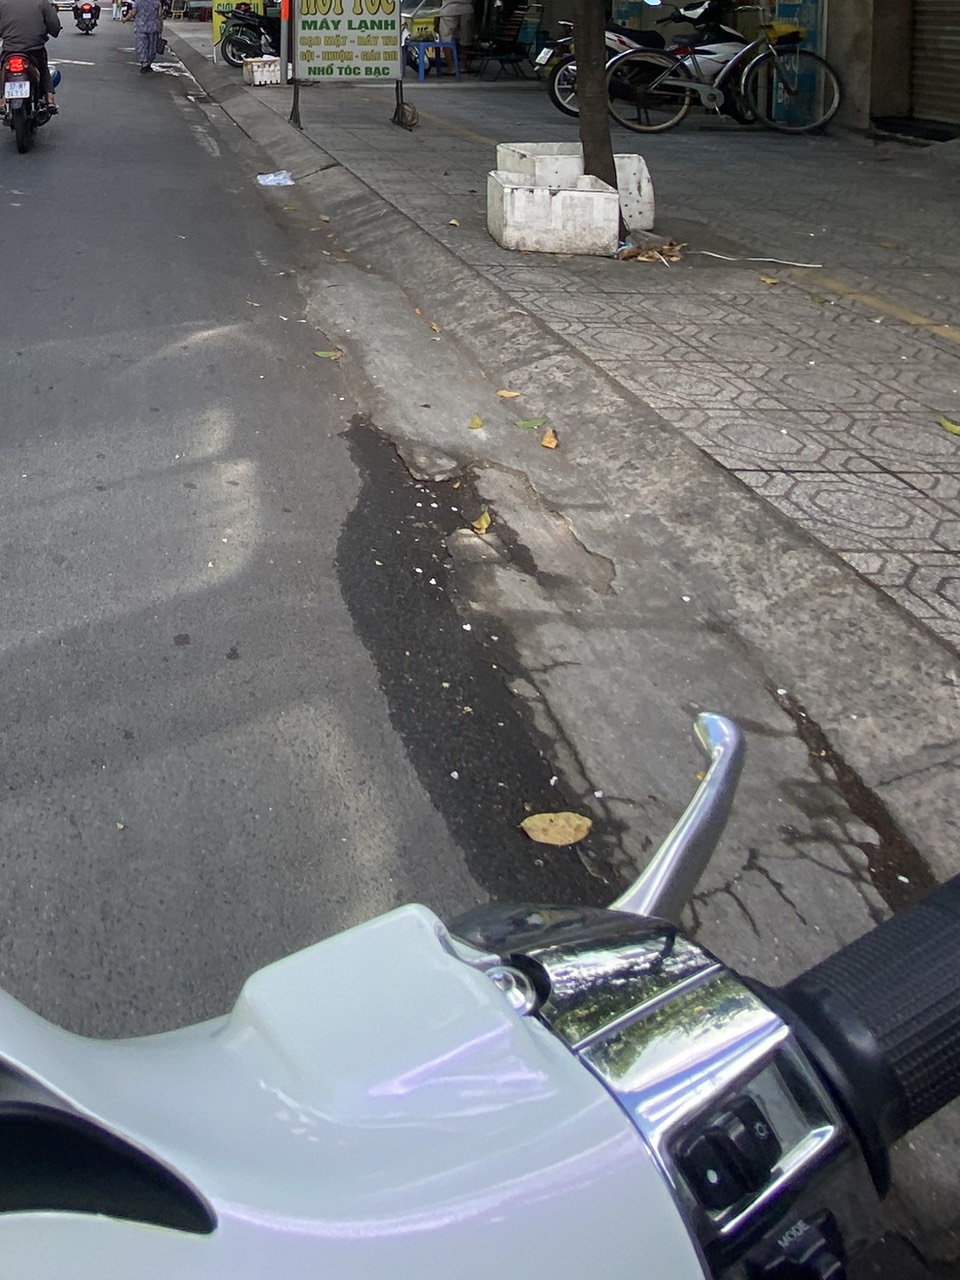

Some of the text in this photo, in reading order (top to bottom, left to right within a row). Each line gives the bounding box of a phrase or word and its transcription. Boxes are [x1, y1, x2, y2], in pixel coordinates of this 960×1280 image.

[301, 18, 396, 32] MÁY LẠNH
[307, 63, 390, 77] NHỔ TÓC BẠC
[777, 1219, 810, 1248] MODE
